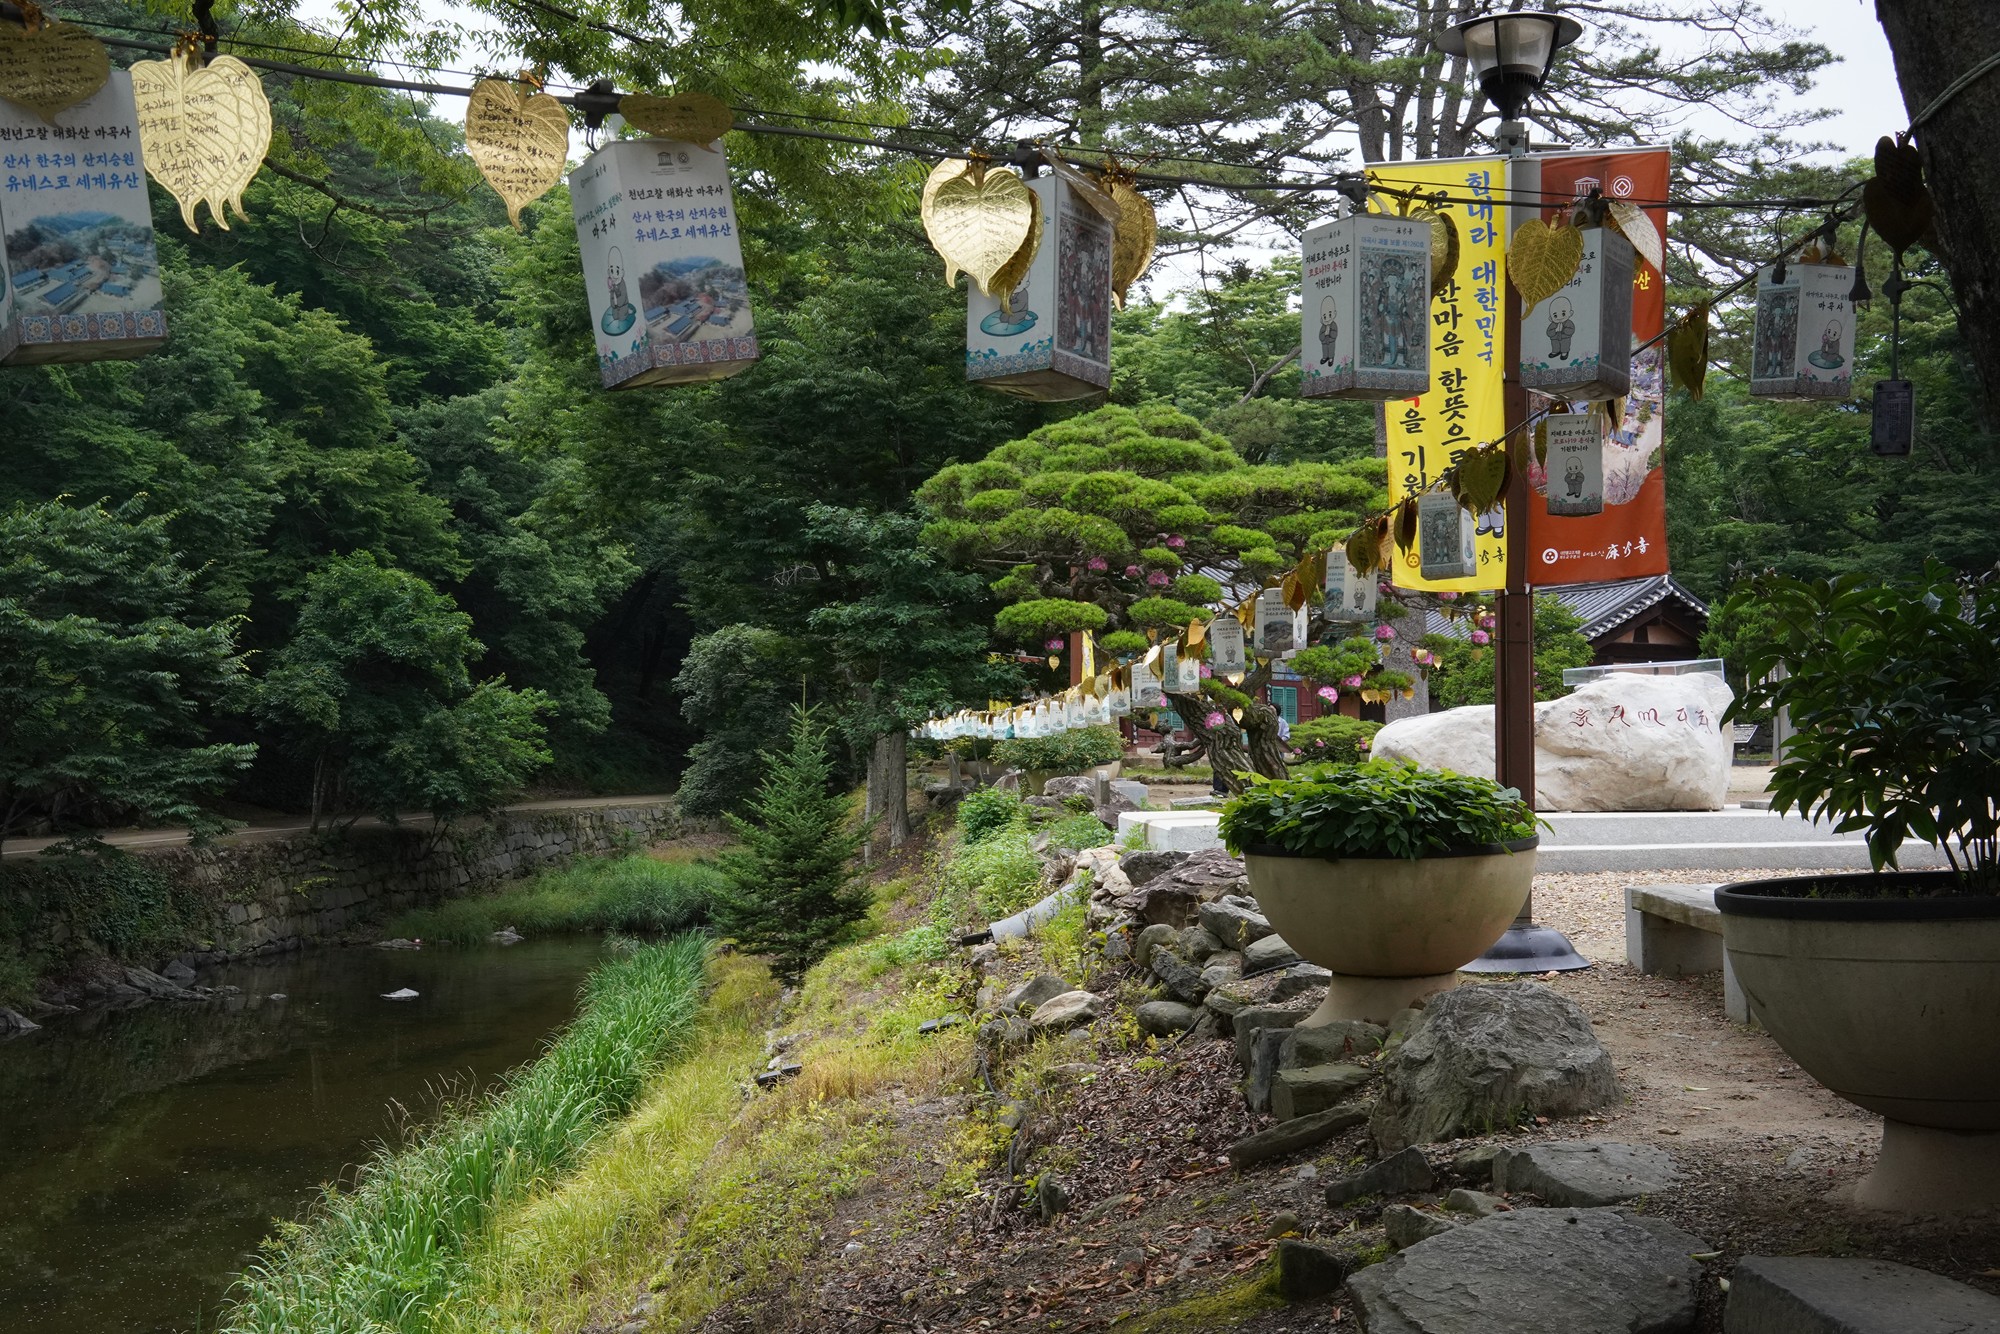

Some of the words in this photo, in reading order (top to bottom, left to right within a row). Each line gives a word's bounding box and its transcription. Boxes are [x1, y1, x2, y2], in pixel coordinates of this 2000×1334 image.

[0, 127, 49, 140] 천년고찰
[53, 126, 91, 140] 태화산
[94, 125, 132, 139] 마곡사
[3, 153, 31, 168] 산사
[35, 152, 76, 168] 한국의
[82, 151, 135, 167] 산지승원
[5, 174, 71, 192] 유네스코
[75, 171, 140, 190] 세계유산
[628, 187, 663, 201] 천년고찰
[666, 186, 693, 199] 태화산
[696, 184, 724, 197] 마곡사
[632, 210, 651, 223] 산사
[656, 209, 685, 223] 한국의
[688, 206, 727, 220] 산지승원
[1465, 170, 1498, 248] 힘내라
[592, 213, 616, 240] 마곡사
[635, 226, 682, 242] 유네스코
[685, 222, 732, 240] 세계유산
[1305, 251, 1327, 265] 지혜로운
[1328, 244, 1351, 259] 마음으로
[1308, 264, 1331, 278] 코로나19
[1332, 258, 1348, 272] 종식을
[1315, 273, 1342, 290] 기원합니다
[1472, 259, 1499, 368] 대한민국
[1818, 301, 1844, 312] 마곡사
[1433, 277, 1465, 357] 한마음
[1437, 368, 1472, 468] 한뜻으로
[1560, 445, 1588, 453] 기원합니다
